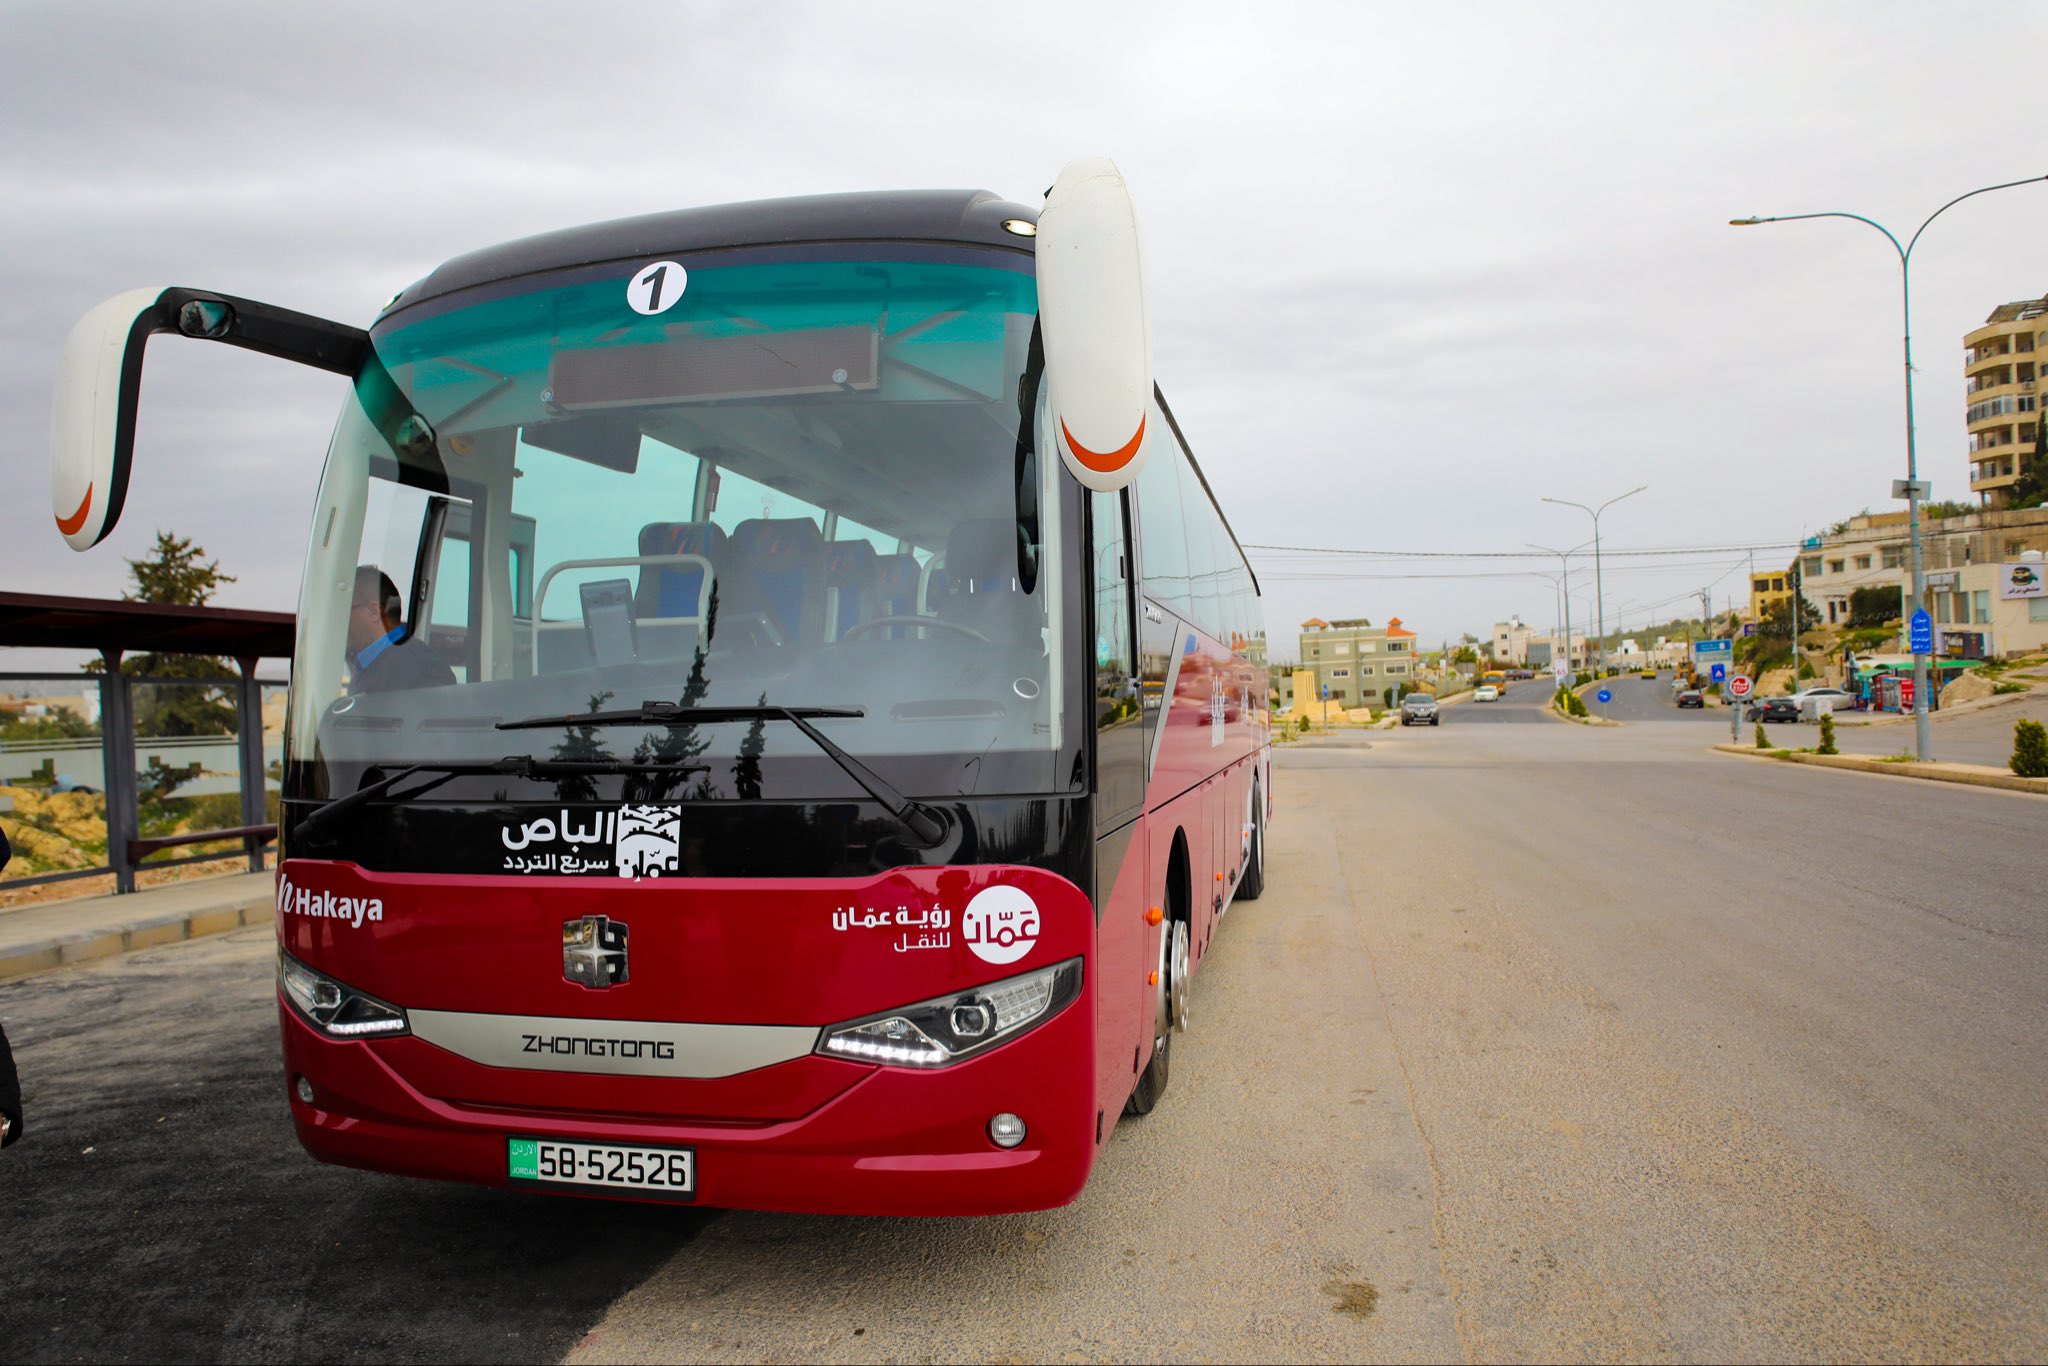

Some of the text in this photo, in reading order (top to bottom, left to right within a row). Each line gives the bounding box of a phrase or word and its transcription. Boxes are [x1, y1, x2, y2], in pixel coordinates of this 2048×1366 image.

[641, 265, 668, 311] 1
[502, 809, 616, 853] الباص
[503, 854, 609, 874] سريع التردد
[295, 887, 383, 929] Hakaya
[896, 903, 951, 929] رؤية
[893, 931, 951, 953] للنقل
[522, 1034, 675, 1060] ZHONGTONG
[512, 1166, 537, 1176] JORDAN
[540, 1145, 686, 1187] 58-52526
